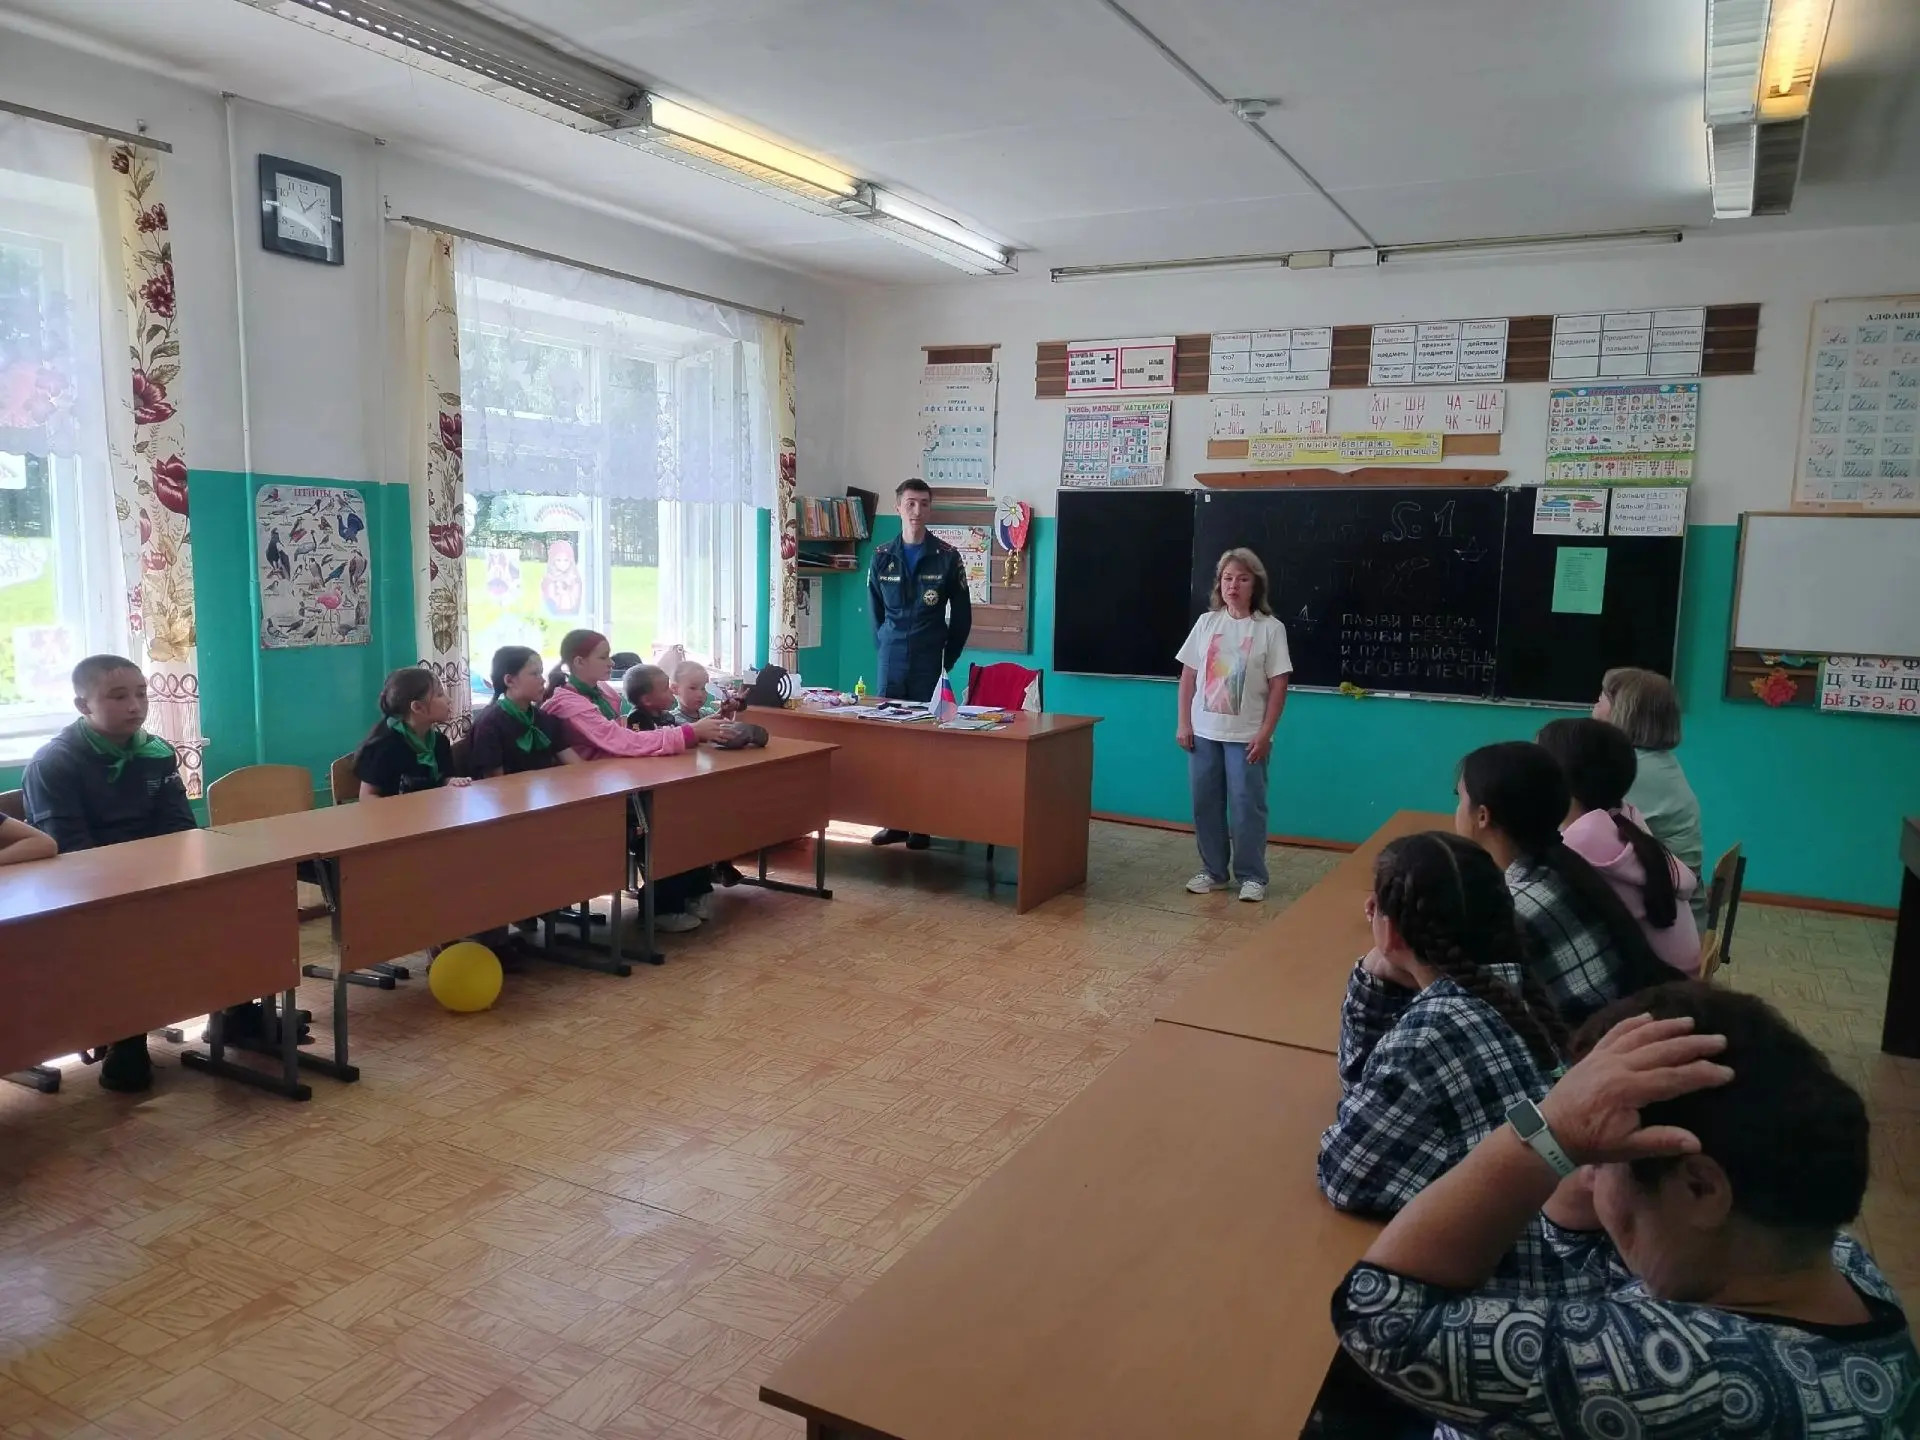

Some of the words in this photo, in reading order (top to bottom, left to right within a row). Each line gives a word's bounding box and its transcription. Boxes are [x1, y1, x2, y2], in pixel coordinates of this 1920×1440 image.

[1371, 396, 1390, 412] ЖИ
[1405, 396, 1425, 411] ШИ
[1447, 394, 1461, 410] ЧА
[1372, 416, 1387, 430] ЧУ
[1446, 415, 1459, 429] ЧК
[1475, 415, 1491, 430] ЧН
[294, 488, 332, 497] ПТИЦЫ
[1342, 613, 1402, 628] ПЛЫВИ
[1341, 630, 1402, 643] ПЛЫВИ
[1903, 660, 1920, 670] Ф
[1826, 673, 1843, 688] Ц
[1851, 675, 1866, 687] Ч
[1876, 676, 1894, 689] Ш
[1901, 678, 1920, 694] Щ
[1824, 693, 1840, 706] Ы
[1848, 695, 1860, 707] Ь
[1872, 696, 1884, 709] Э
[1897, 698, 1916, 711] Ю
